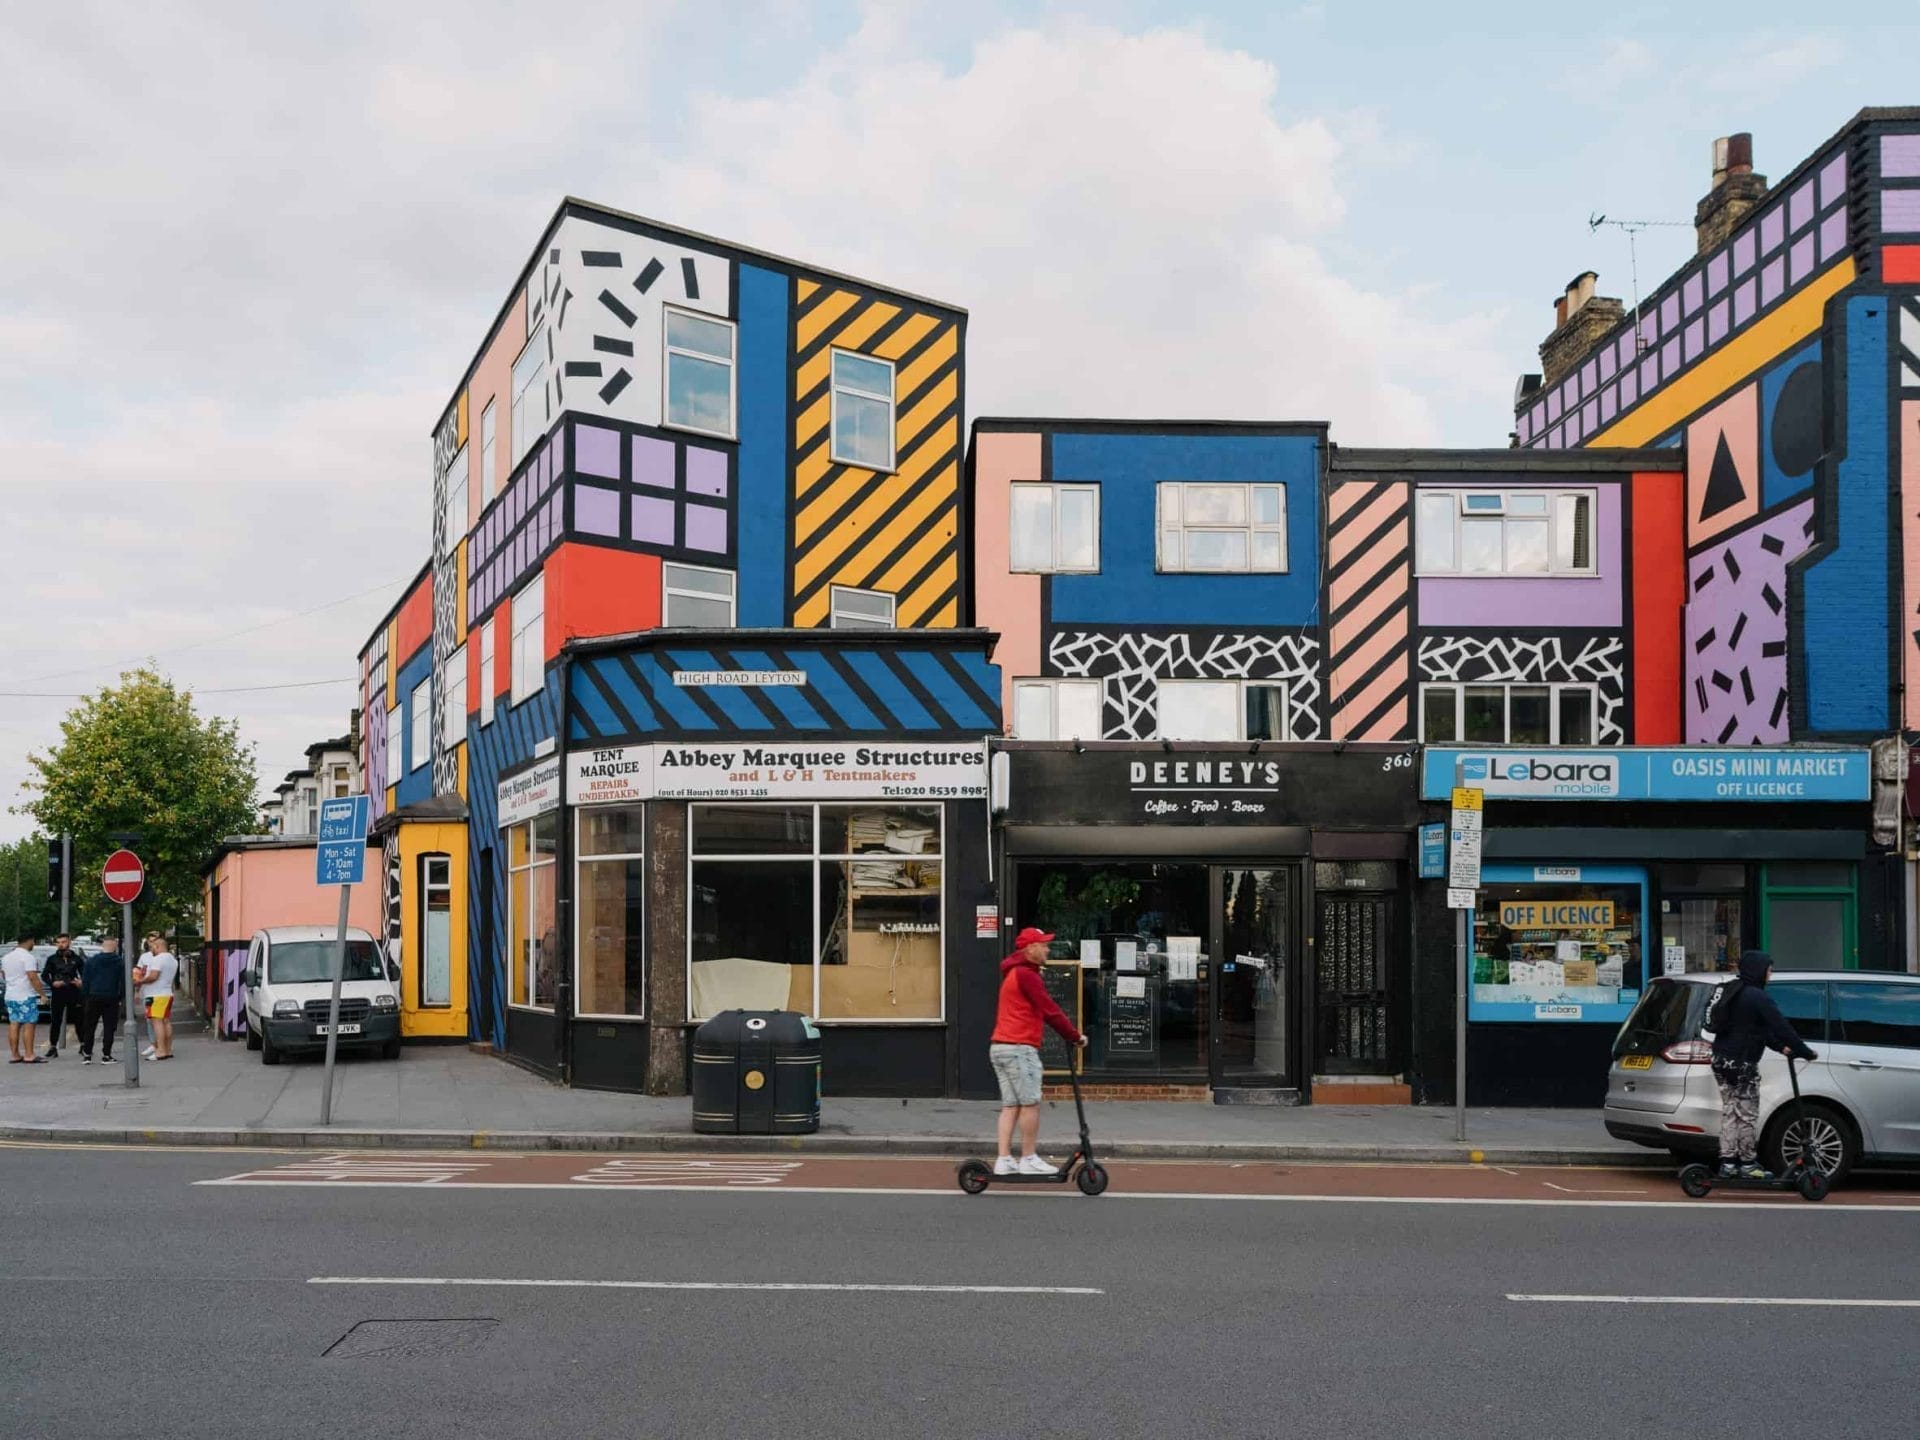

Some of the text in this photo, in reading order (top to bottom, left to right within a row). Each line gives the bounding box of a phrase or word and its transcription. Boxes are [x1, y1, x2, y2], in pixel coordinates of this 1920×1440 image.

[679, 673, 800, 684] HIGH ROAD LEYTON
[592, 749, 624, 762] TENT
[660, 748, 985, 770] Abbey Marquee Structures
[1382, 753, 1412, 771] 360
[580, 761, 640, 778] MARQUEE
[1130, 761, 1280, 784] DEENEY'S
[1490, 758, 1611, 781] Lebara
[1672, 758, 1848, 777] OASIS MINI MARKET
[729, 769, 917, 782] and L & H Tentmakers
[590, 778, 629, 791] REPAIRS
[1554, 783, 1611, 794] mobile
[1716, 782, 1804, 796] OFF LICENCE
[578, 788, 640, 801] UNDERTAKEN
[658, 788, 674, 797] (out
[677, 788, 684, 797] of
[686, 788, 714, 797] Hours)
[929, 786, 958, 797] 8539
[1144, 799, 1266, 815] Coffee Food Booze
[335, 824, 350, 836] taxi
[324, 847, 339, 858] Mon
[343, 846, 356, 857] Sat
[1545, 867, 1577, 876] Lebara
[1503, 906, 1610, 925] OFF LICENCE
[1546, 1005, 1578, 1014] Lebara
[208, 1154, 526, 1183] LANE
[570, 1160, 804, 1184] BUS
